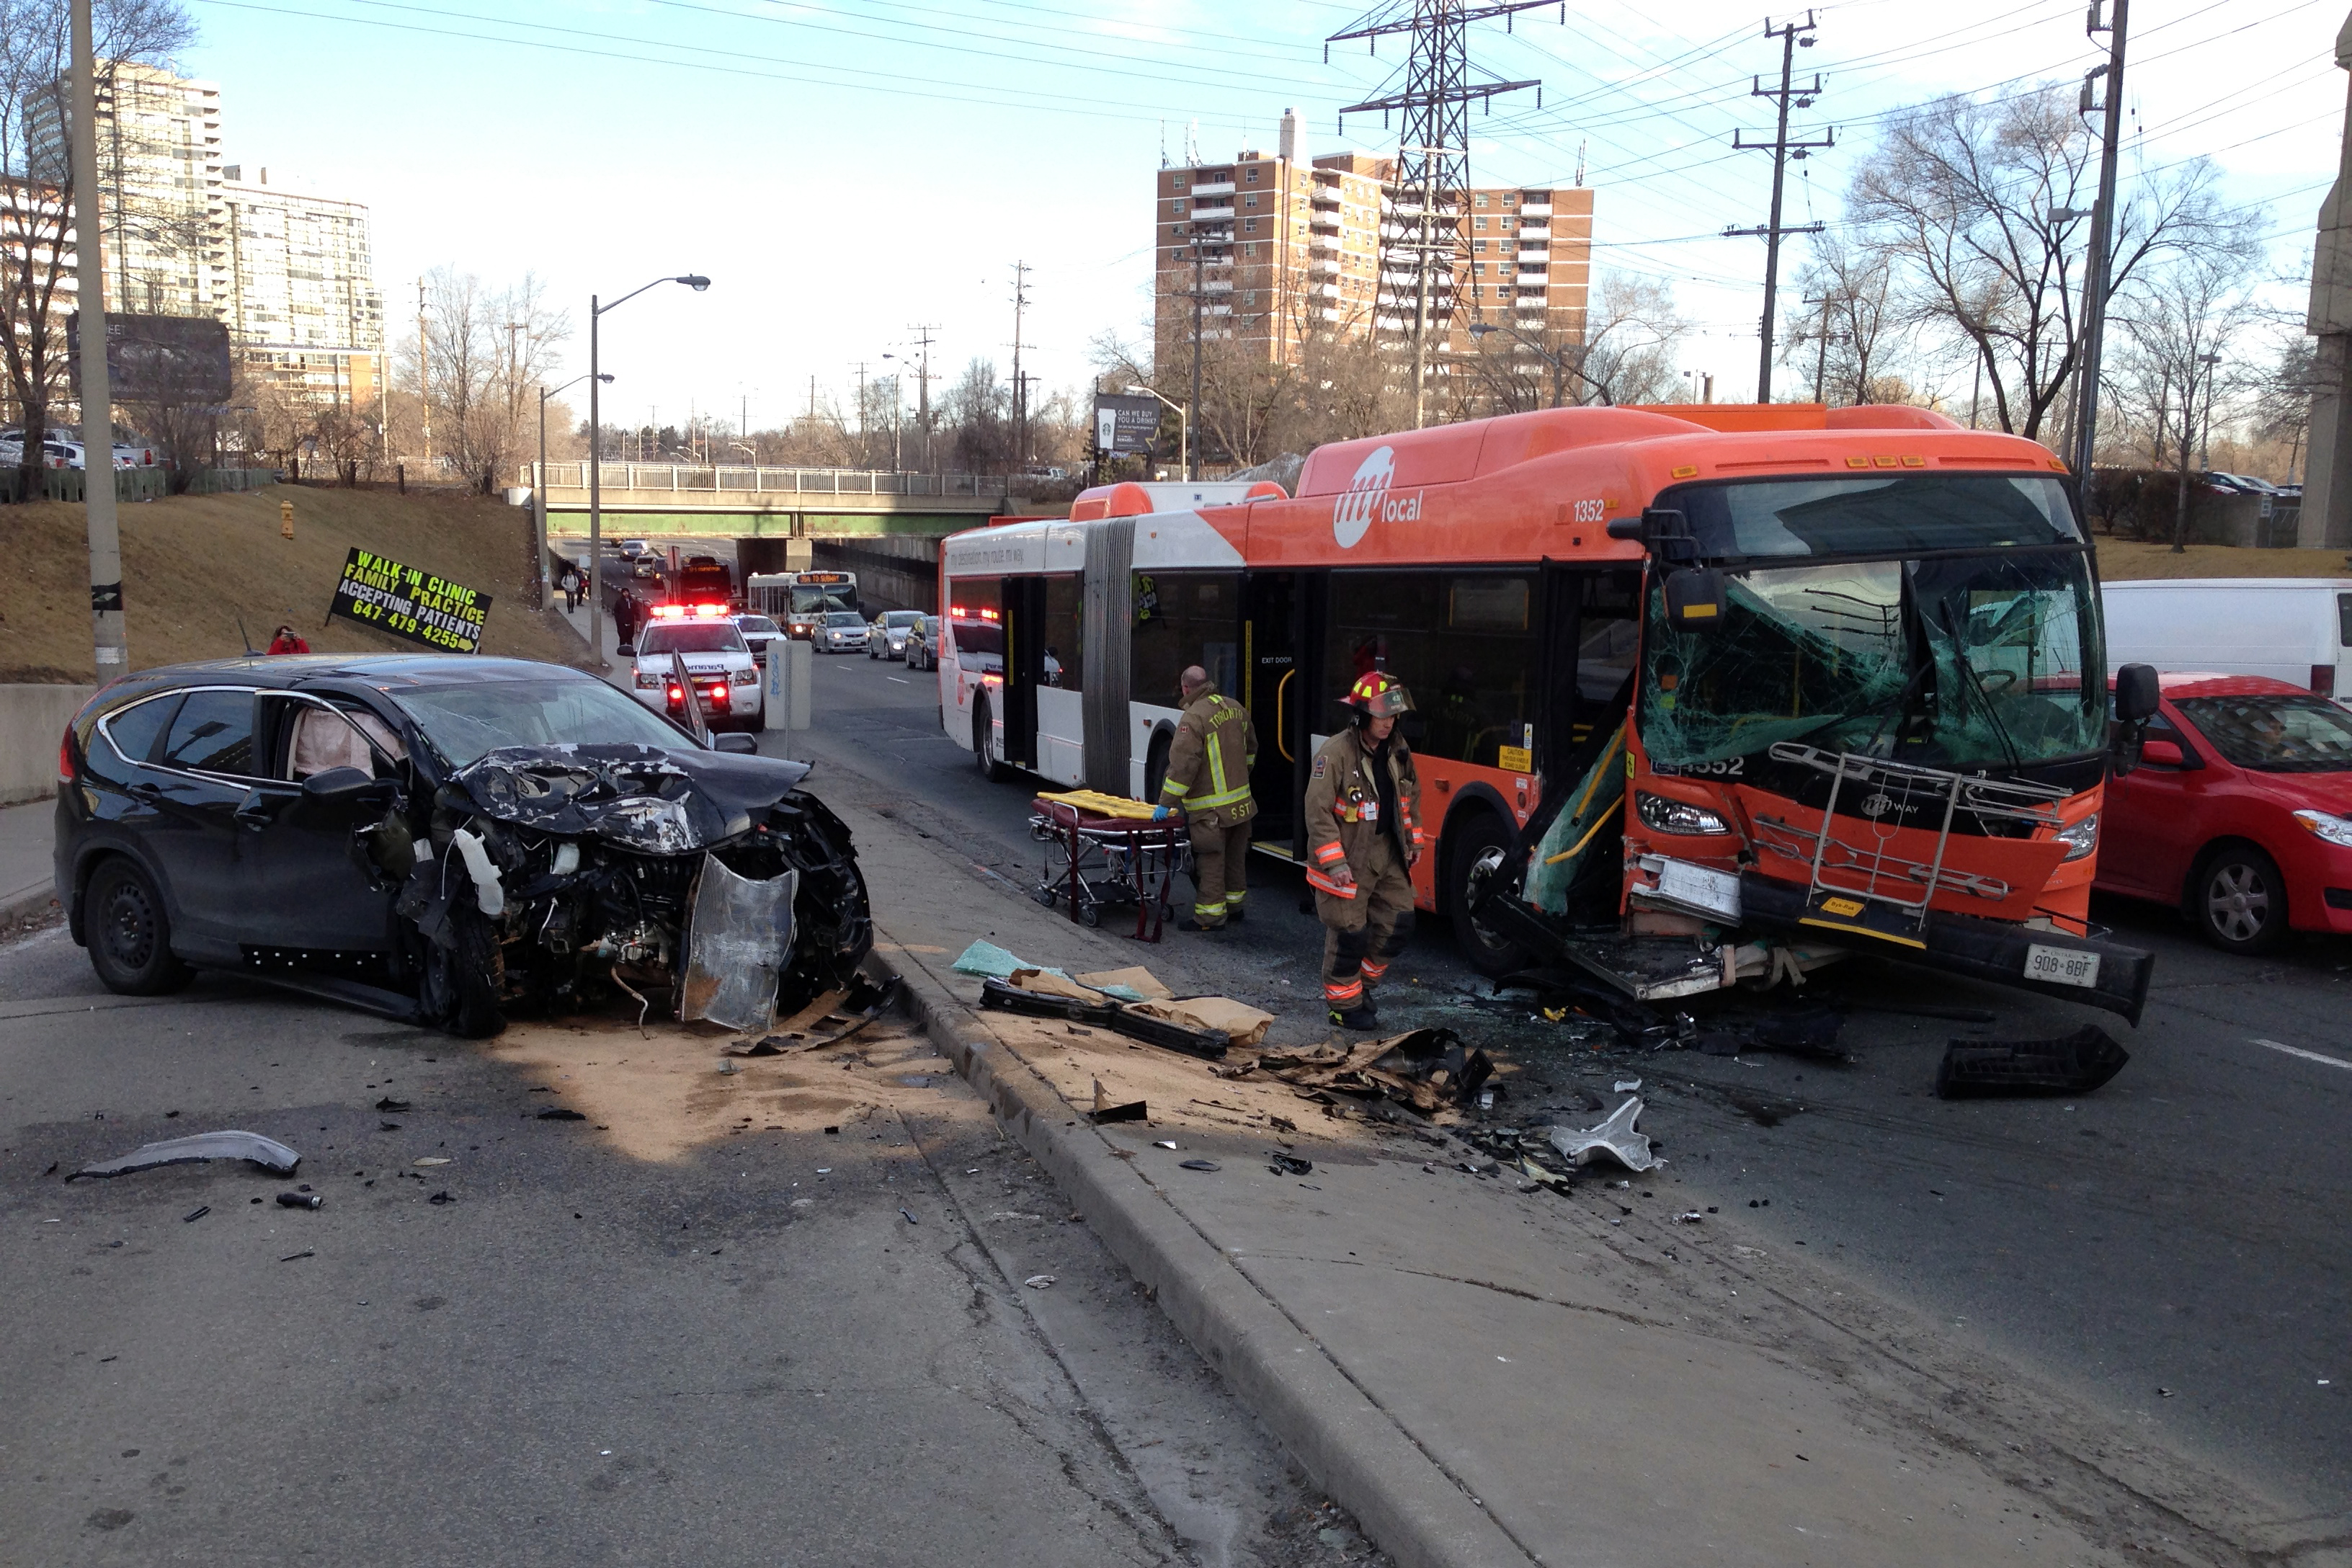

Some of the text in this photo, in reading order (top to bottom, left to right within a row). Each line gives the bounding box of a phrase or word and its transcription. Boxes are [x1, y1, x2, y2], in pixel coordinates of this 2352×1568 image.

[1381, 490, 1424, 522] local
[1574, 499, 1604, 522] 1352
[357, 551, 476, 605] WALK-IN CLINIC
[344, 563, 485, 625] FAMILY PRACTICE
[339, 579, 481, 640] ACCEPTING PATIENTS
[1209, 708, 1243, 729] TORONTO
[1507, 747, 1524, 757] CAUTION
[1893, 802, 1919, 814] WAY
[2034, 955, 2091, 977] 908 8BF
